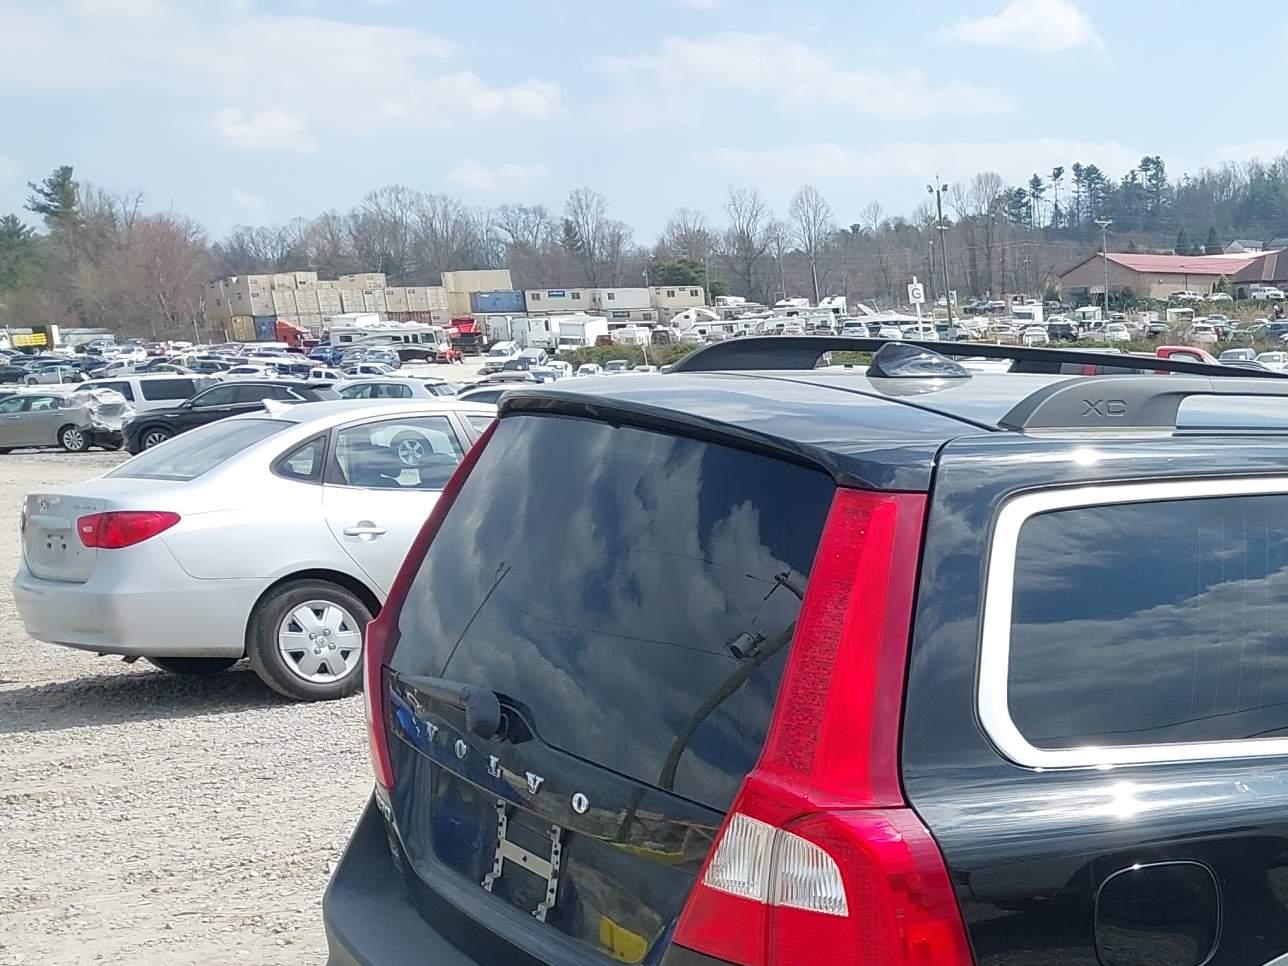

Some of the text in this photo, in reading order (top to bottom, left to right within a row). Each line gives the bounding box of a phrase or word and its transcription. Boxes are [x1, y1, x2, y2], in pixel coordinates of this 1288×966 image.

[912, 287, 922, 299] G
[1082, 399, 1127, 417] XC
[426, 721, 590, 815] VOLVO
